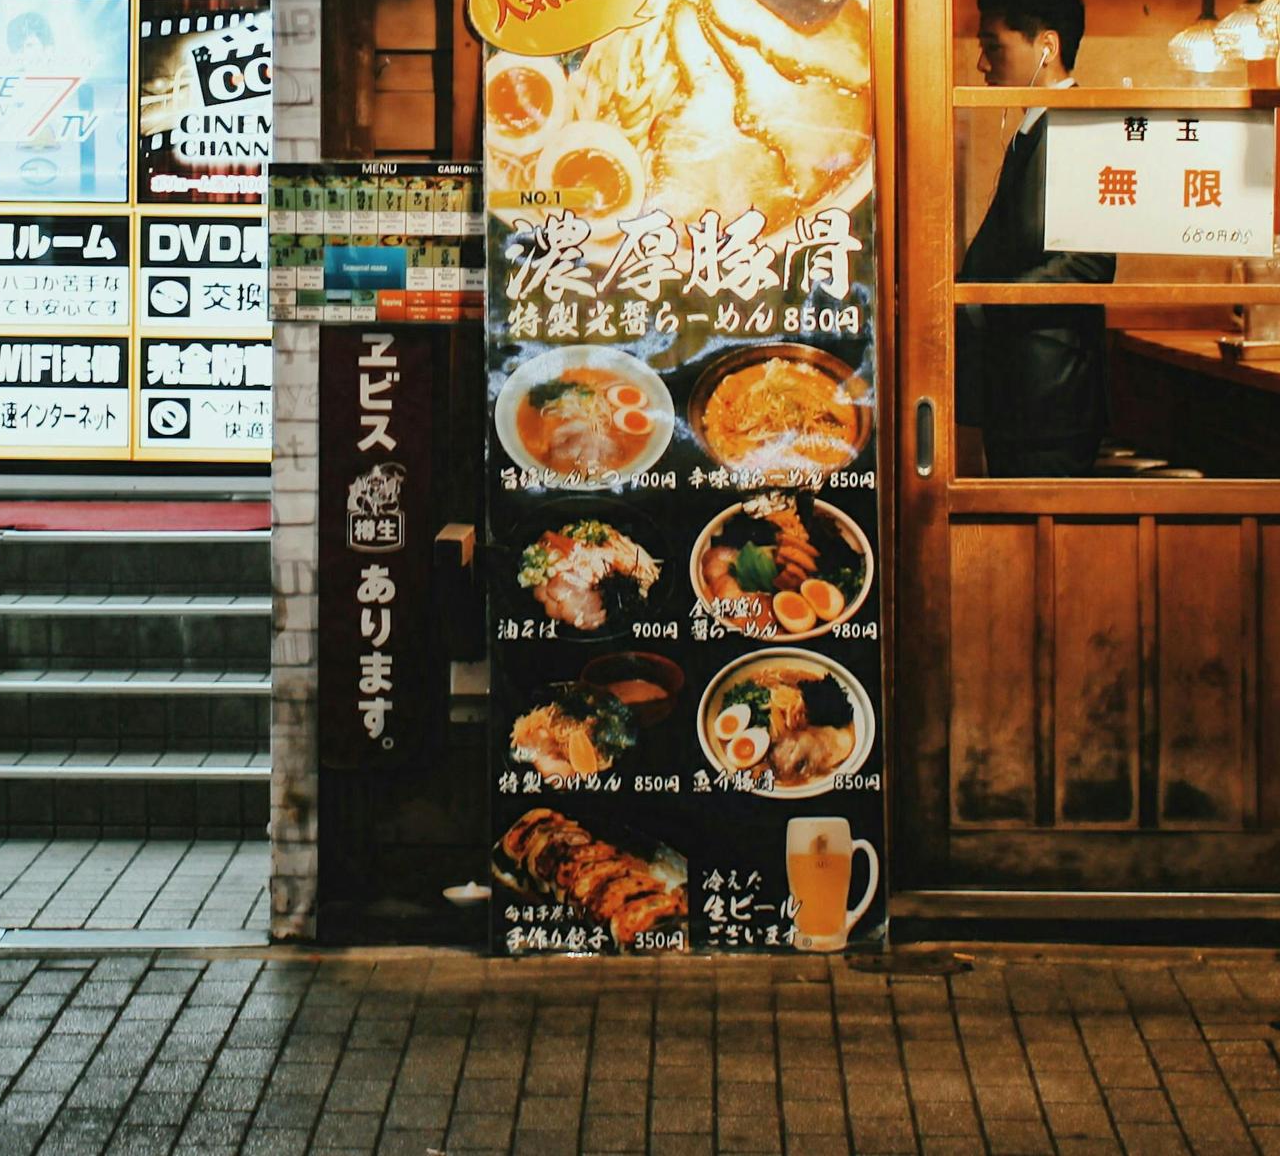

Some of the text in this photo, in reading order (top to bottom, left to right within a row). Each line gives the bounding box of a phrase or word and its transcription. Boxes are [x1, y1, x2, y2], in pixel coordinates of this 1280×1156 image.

[25, 76, 81, 137] 7
[61, 115, 97, 137] TV
[1124, 115, 1200, 143] 替玉
[361, 163, 398, 175] MENU
[520, 191, 562, 205] NO.1
[1097, 165, 1223, 208] 無限
[505, 207, 863, 301] 濃厚豚骨
[782, 305, 860, 334] 850円
[630, 471, 677, 490] 900円
[829, 471, 876, 489] 850円
[354, 518, 398, 542] 樽生
[497, 617, 679, 640] 油そば 900円
[831, 621, 878, 641] 980円
[357, 563, 397, 750] あります。
[633, 774, 681, 793] 850円
[833, 773, 882, 792] 850円
[701, 869, 764, 894] 冷えた
[702, 896, 803, 922] 生ビール
[504, 925, 685, 951] 手作り餃子 350円
[705, 924, 800, 946] ございます
